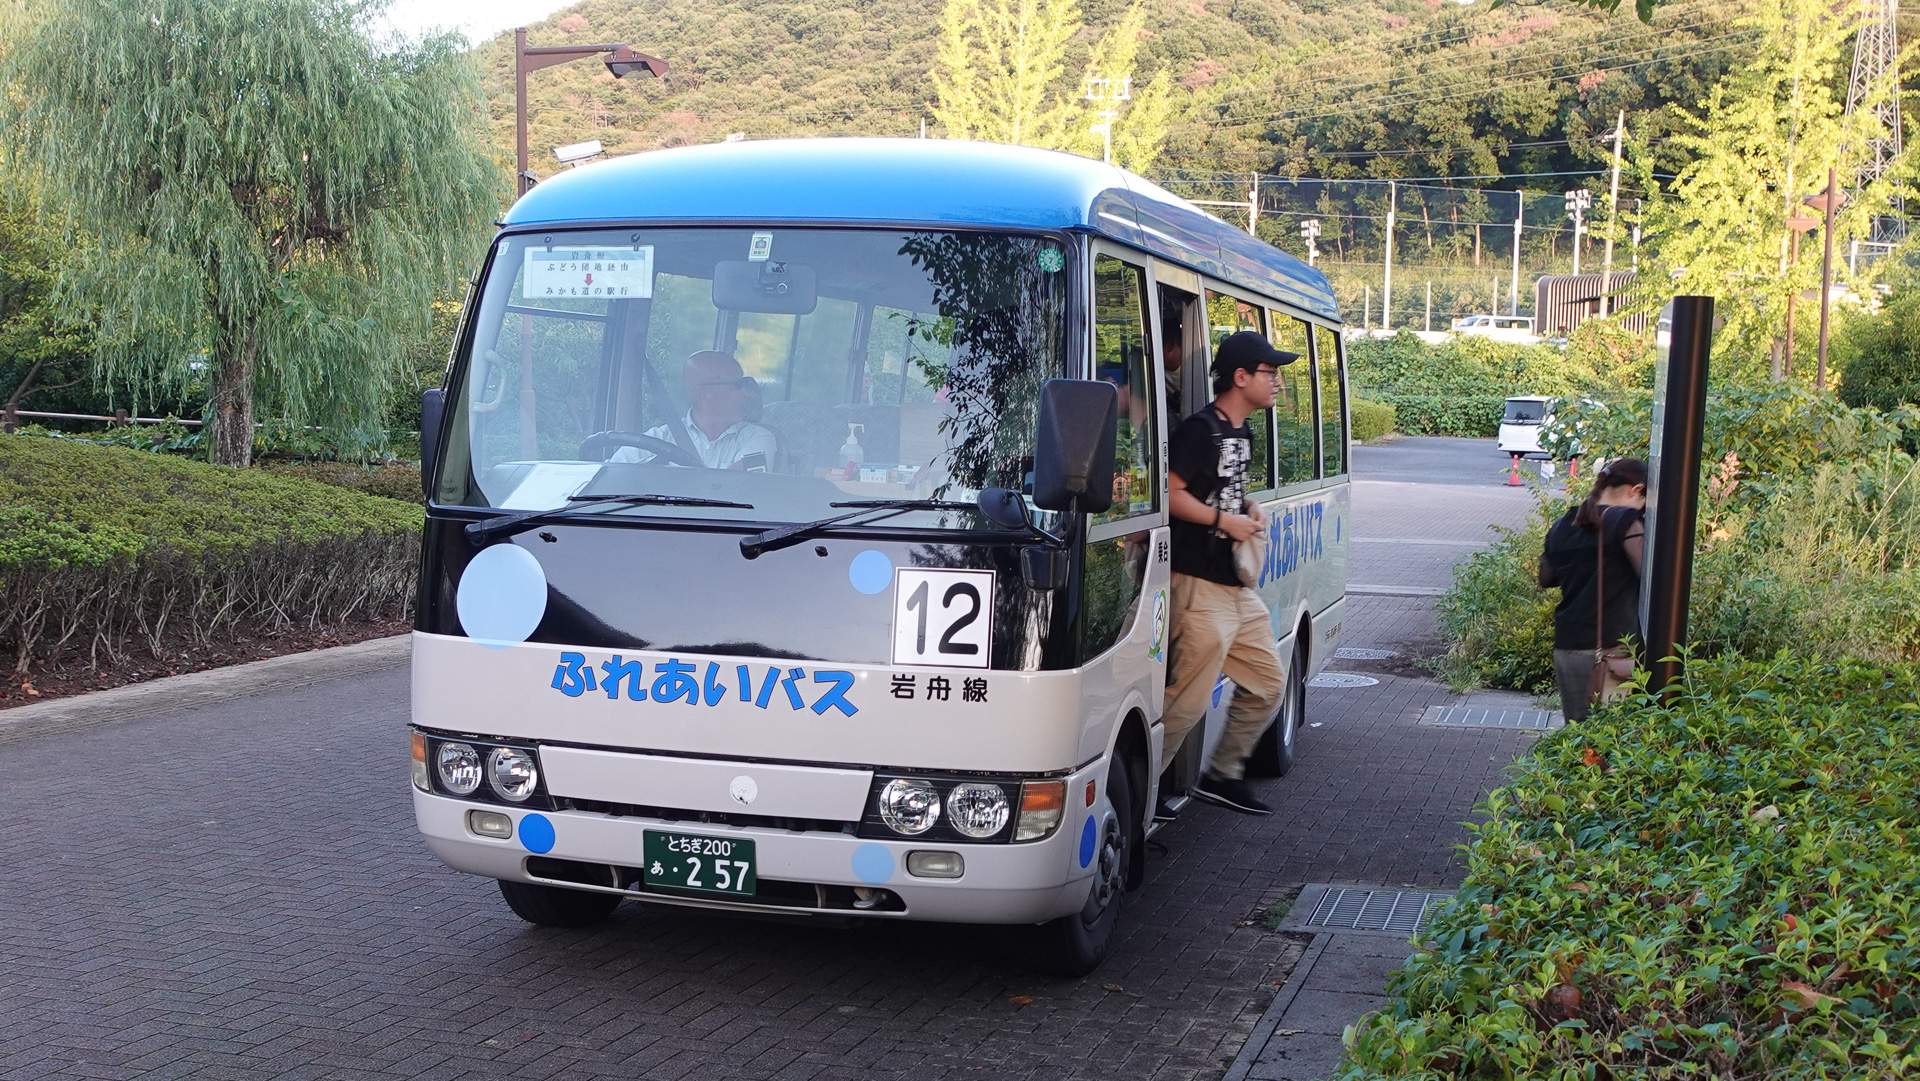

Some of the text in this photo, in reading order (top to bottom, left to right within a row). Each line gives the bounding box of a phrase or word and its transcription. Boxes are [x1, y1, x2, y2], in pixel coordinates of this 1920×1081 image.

[571, 251, 605, 260] 岩舟線
[547, 262, 629, 272] ぶどう団地経由
[546, 286, 629, 296] みかも道の駅行
[906, 580, 981, 655] 12
[551, 651, 859, 718] ふれあいバス
[890, 673, 988, 703] 岩舟線
